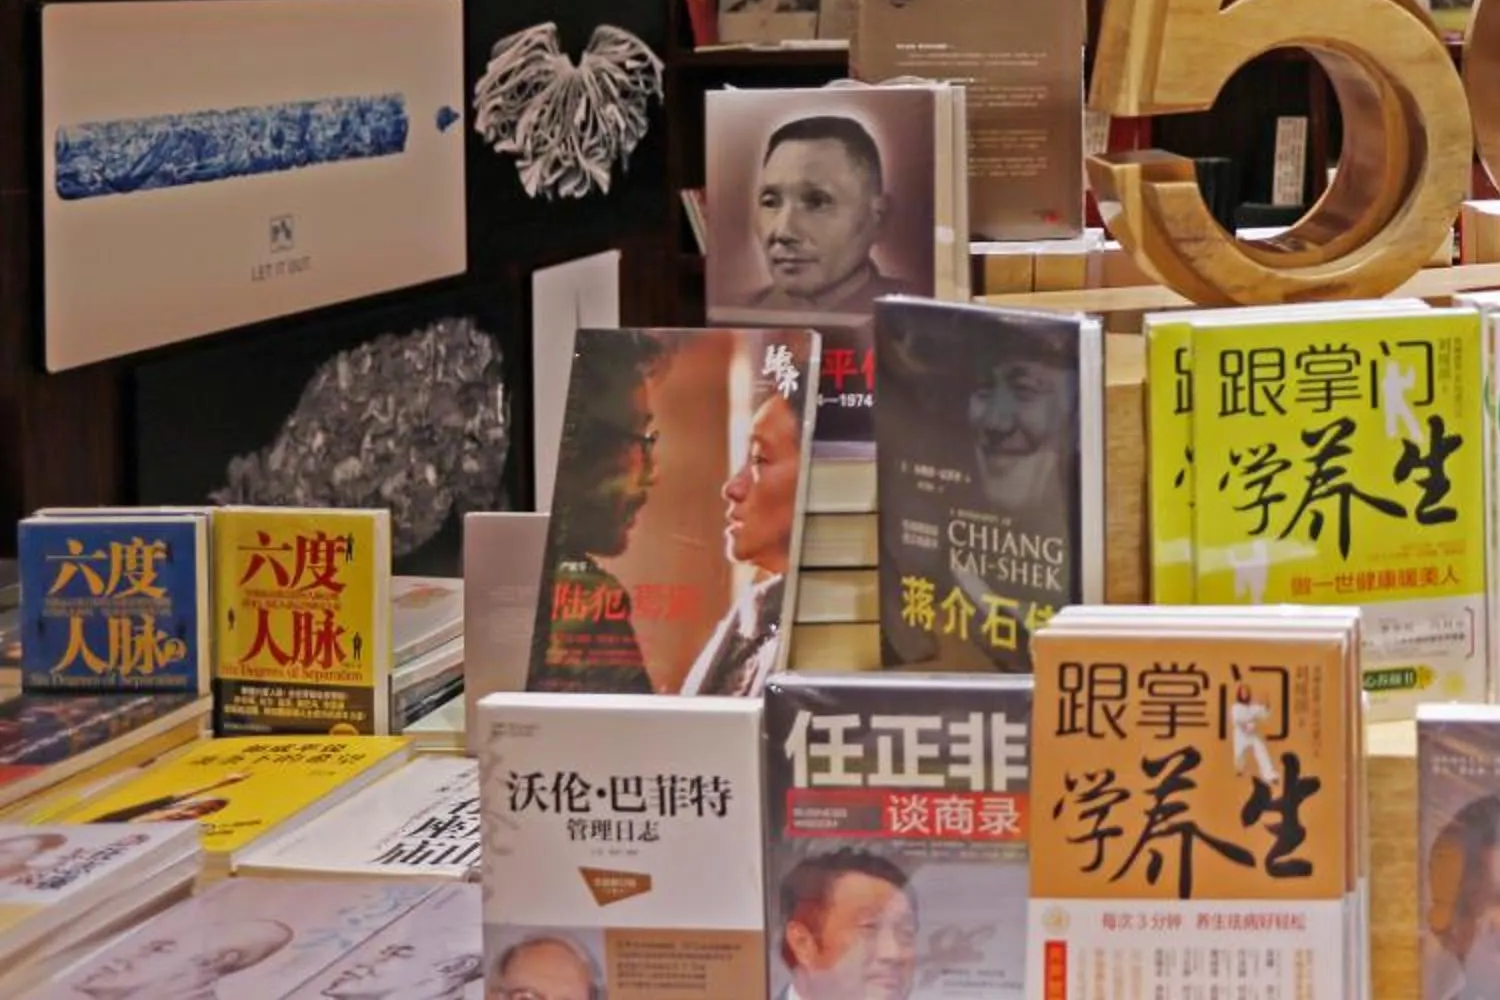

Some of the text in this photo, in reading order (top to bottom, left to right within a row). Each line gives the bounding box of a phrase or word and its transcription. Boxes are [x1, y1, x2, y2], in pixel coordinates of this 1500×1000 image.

[251, 263, 272, 282] LET
[1218, 341, 1435, 418] 跟掌门
[1218, 414, 1465, 560] 学养生
[45, 535, 169, 600] 六度
[237, 530, 347, 593] 六度
[947, 519, 1064, 565] CHIANG
[949, 548, 1062, 593] KAI-SHEK
[238, 608, 348, 670] 人脉
[1055, 661, 1291, 740] 跟掌门
[784, 709, 1029, 791] 任正非
[566, 818, 662, 843] 管理日志
[888, 794, 1022, 835] 谈商录
[1052, 745, 1322, 900] 学养生
